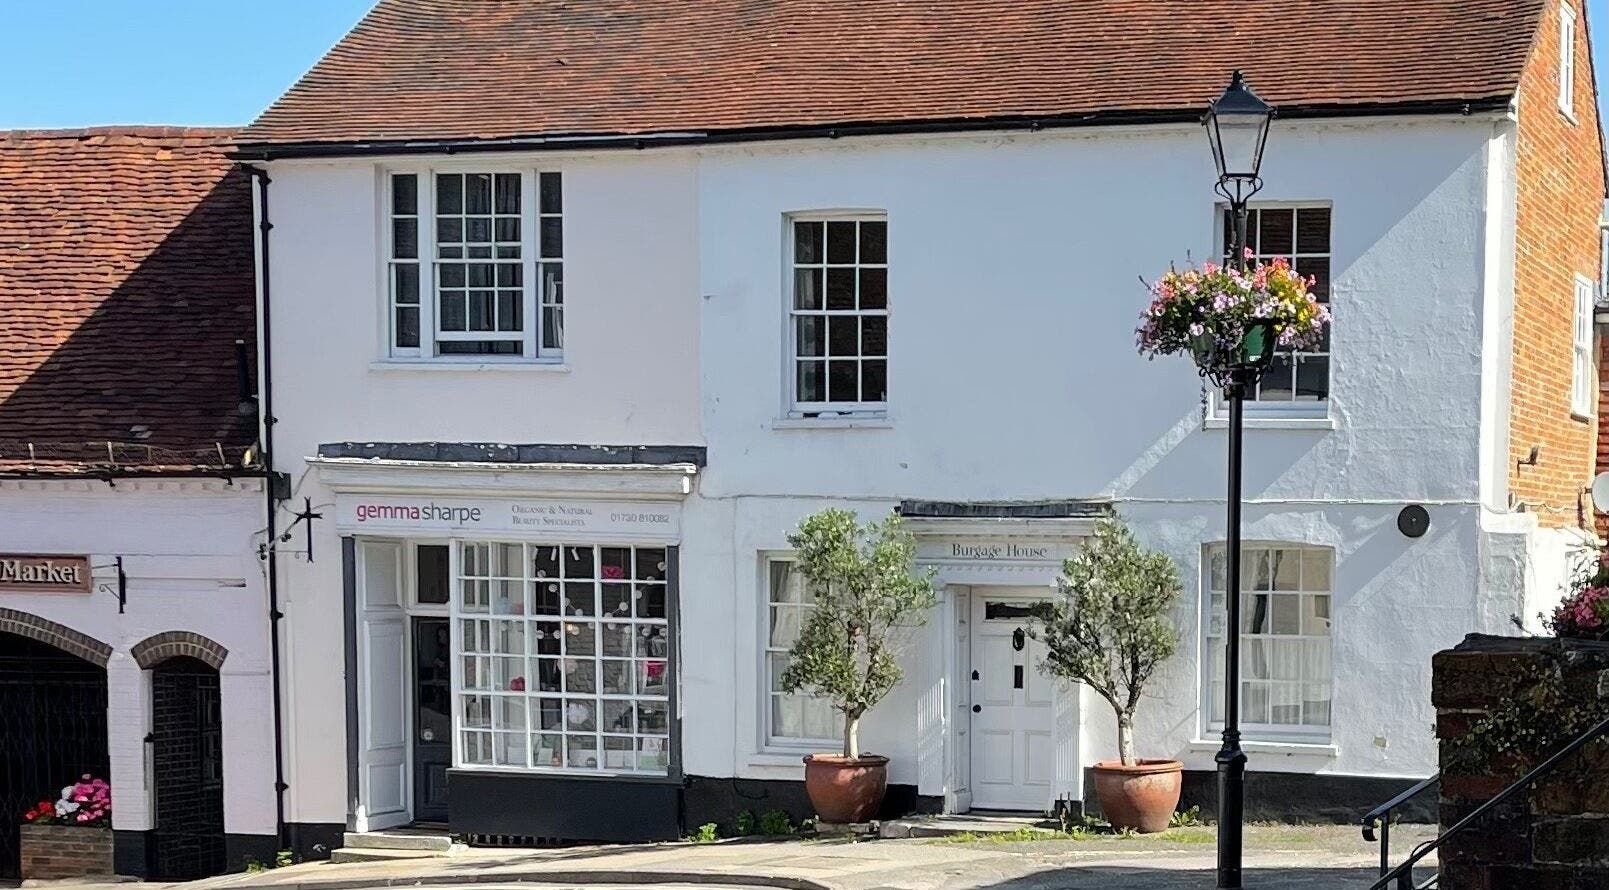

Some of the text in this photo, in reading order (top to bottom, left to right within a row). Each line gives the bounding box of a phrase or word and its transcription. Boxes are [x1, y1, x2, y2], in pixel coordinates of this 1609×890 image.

[511, 504, 593, 515] ORGANIC & NATURAL
[512, 515, 586, 526] BEAUTY SPECIALISTS
[952, 543, 1048, 559] Burgage House
[0, 559, 81, 583] Market
